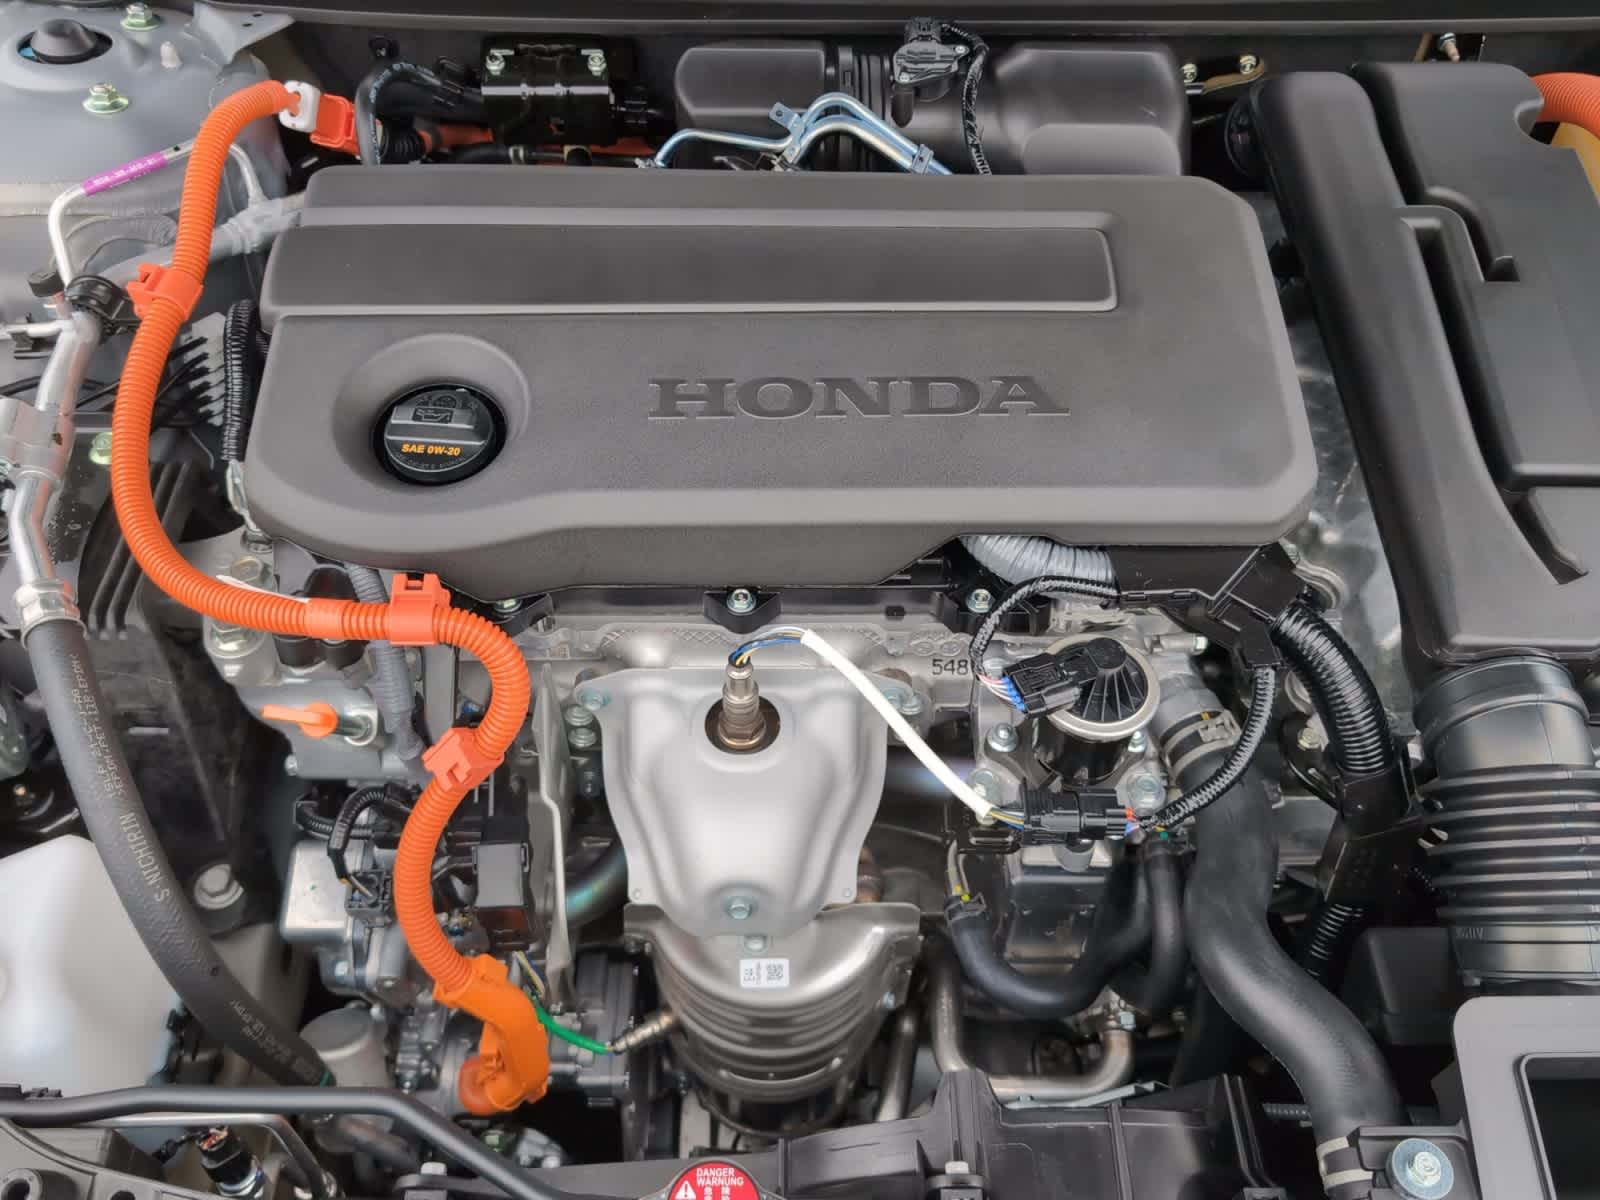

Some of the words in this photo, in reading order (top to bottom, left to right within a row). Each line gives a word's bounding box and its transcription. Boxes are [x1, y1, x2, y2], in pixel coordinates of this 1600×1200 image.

[648, 376, 1071, 420] HONDA
[401, 443, 425, 454] SAE
[427, 445, 461, 456] 0W-20
[932, 658, 969, 676] 548
[696, 1167, 735, 1177] DANGER
[696, 1176, 744, 1187] WARNUNG
